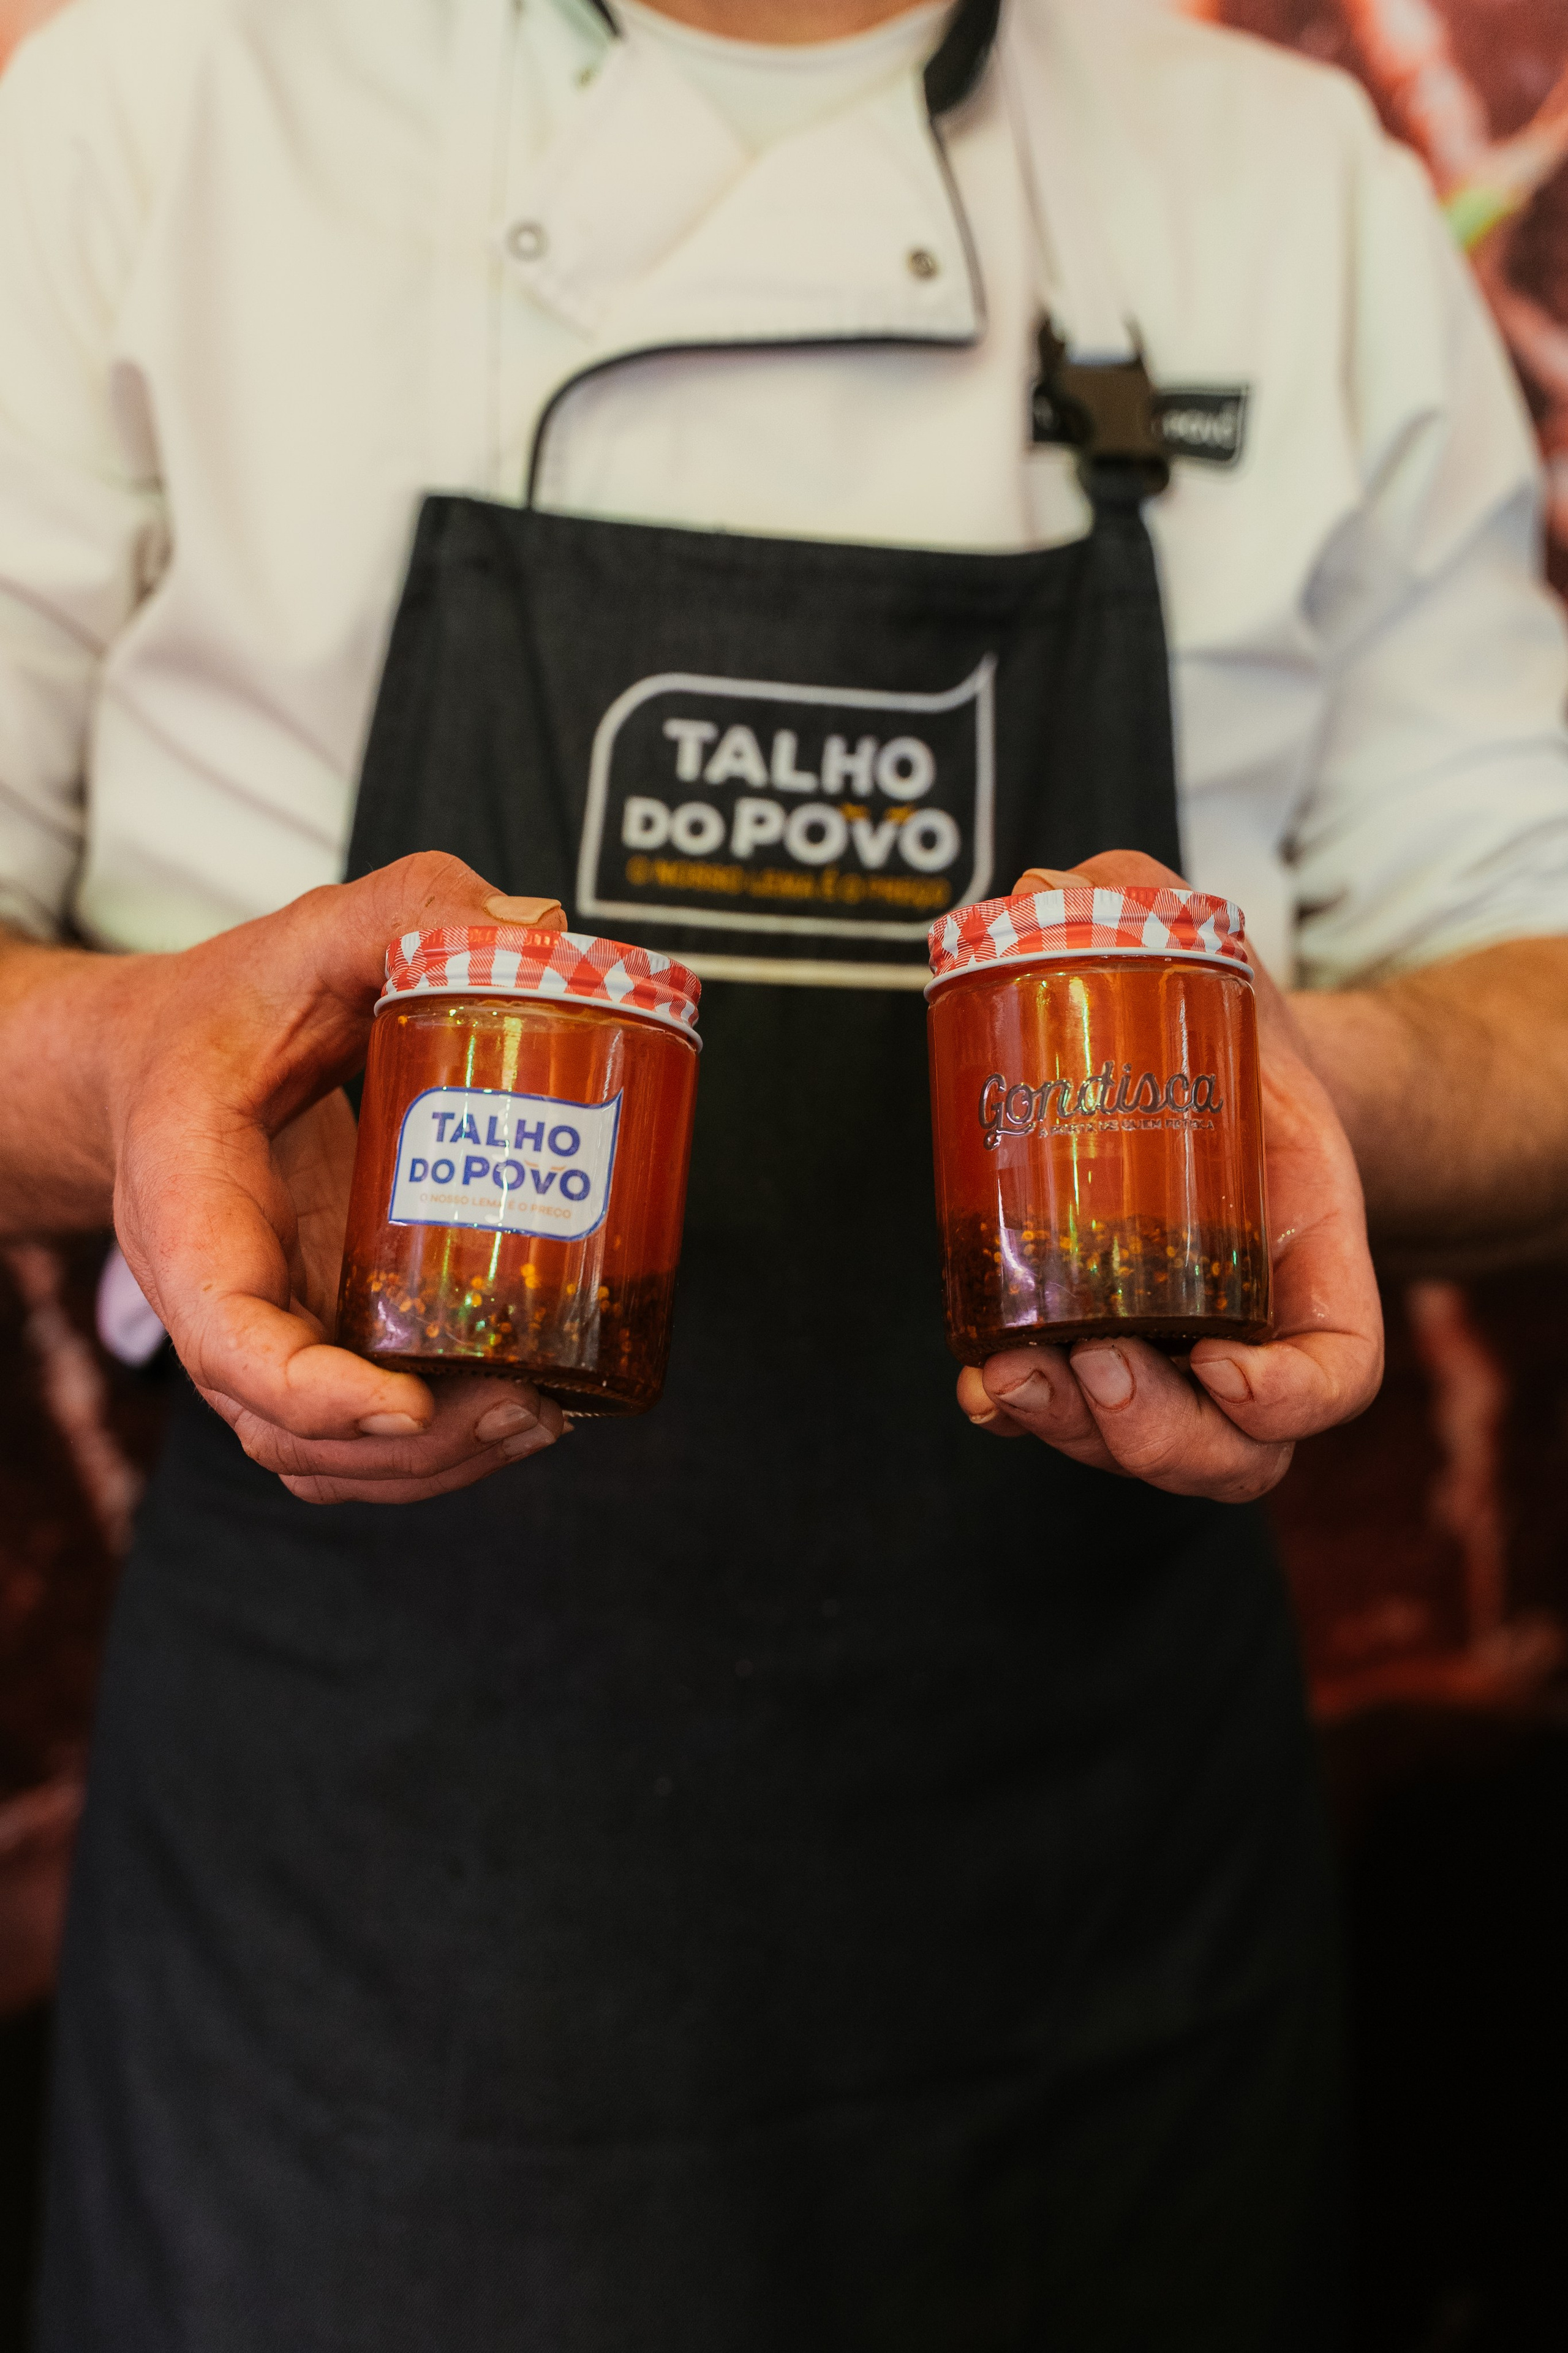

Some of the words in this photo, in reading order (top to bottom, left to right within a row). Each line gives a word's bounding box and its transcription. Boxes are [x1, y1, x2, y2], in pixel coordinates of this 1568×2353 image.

[663, 719, 936, 800] TALHO
[621, 796, 726, 856] DO
[730, 798, 961, 873] POVO
[432, 1112, 580, 1157] TALHO
[409, 1158, 455, 1184] DO
[462, 1155, 591, 1201] POVO
[420, 1193, 428, 1203] O
[431, 1194, 470, 1205] NOSSO
[518, 1201, 528, 1212] O
